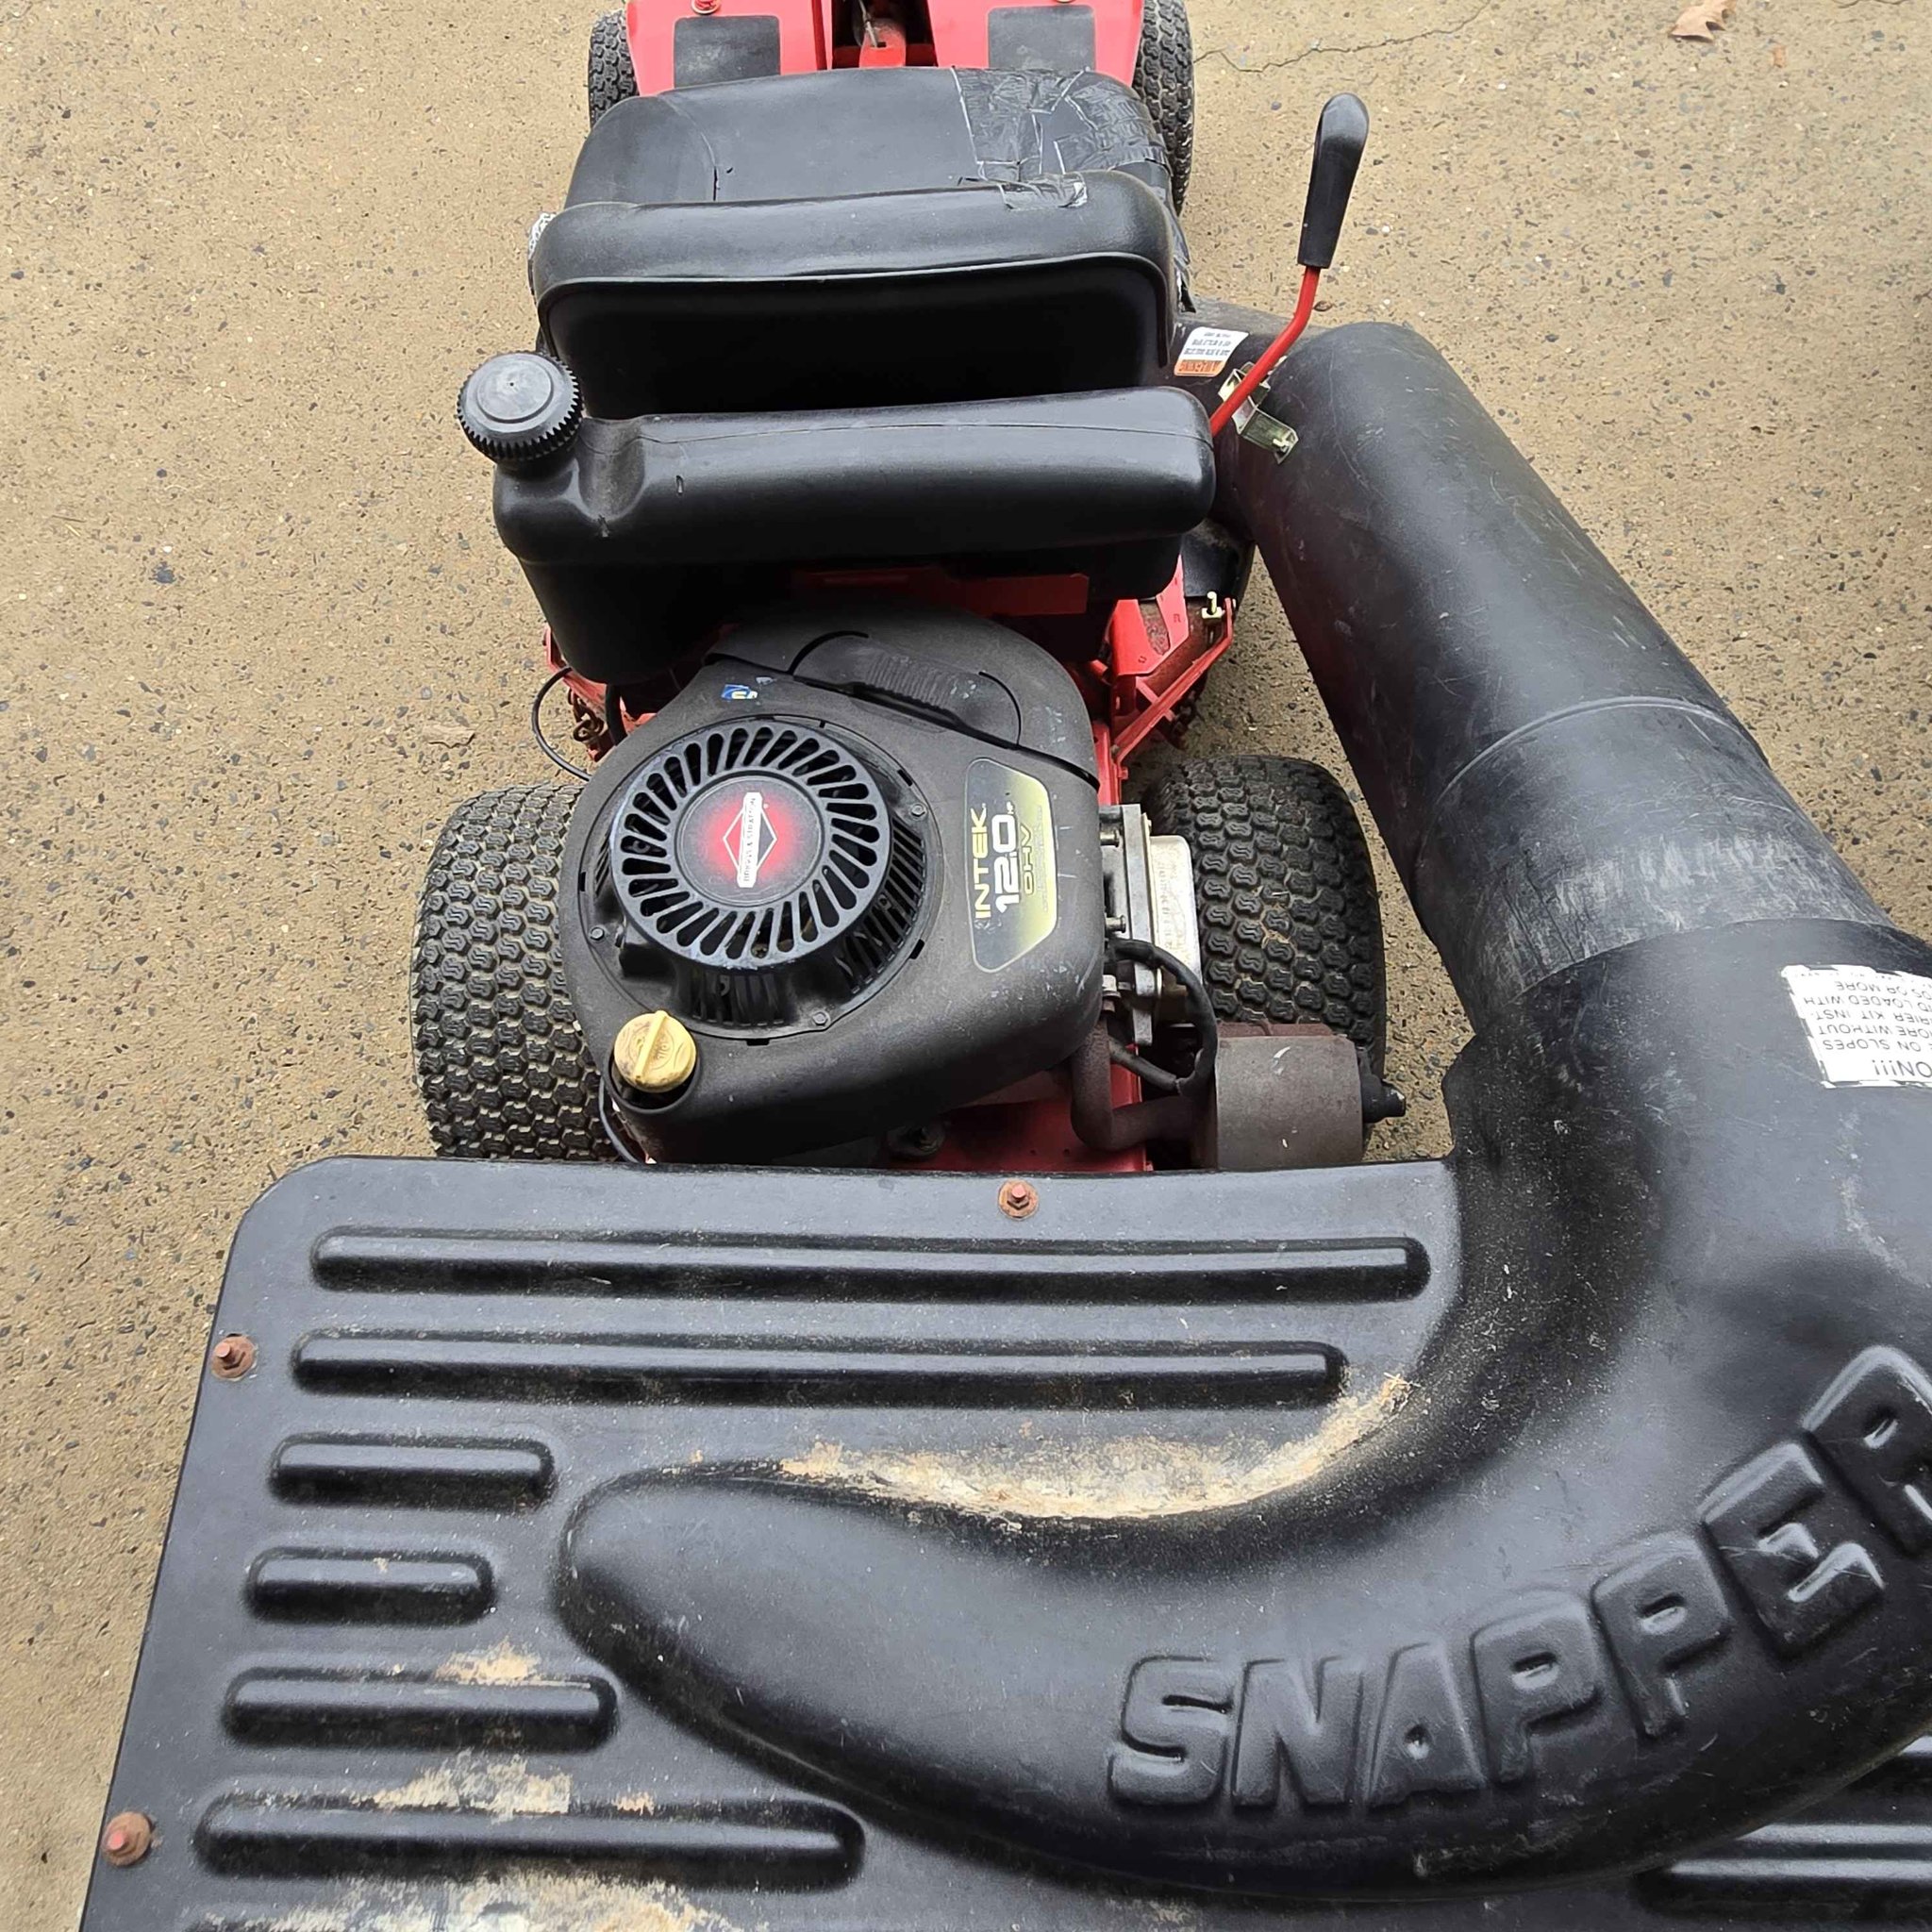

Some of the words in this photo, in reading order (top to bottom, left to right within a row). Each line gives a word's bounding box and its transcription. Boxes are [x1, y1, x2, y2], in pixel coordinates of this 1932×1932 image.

[970, 807, 991, 919] INTEK
[991, 814, 1020, 914] 12.0
[1019, 823, 1035, 896] OHV
[1835, 981, 1881, 992] MORE
[1803, 995, 1843, 1006] WITH
[1848, 995, 1913, 1009] LOADED
[1861, 1010, 1885, 1020] KIT
[1892, 1012, 1932, 1025] RIER
[1818, 1024, 1892, 1035] WITHOUT
[1895, 1025, 1932, 1039] ORE
[1823, 1039, 1890, 1050] SLOPES
[1897, 1041, 1922, 1052] ON
[1871, 1059, 1932, 1078] ON!!!
[1107, 1345, 1932, 1808] SNAPPER
